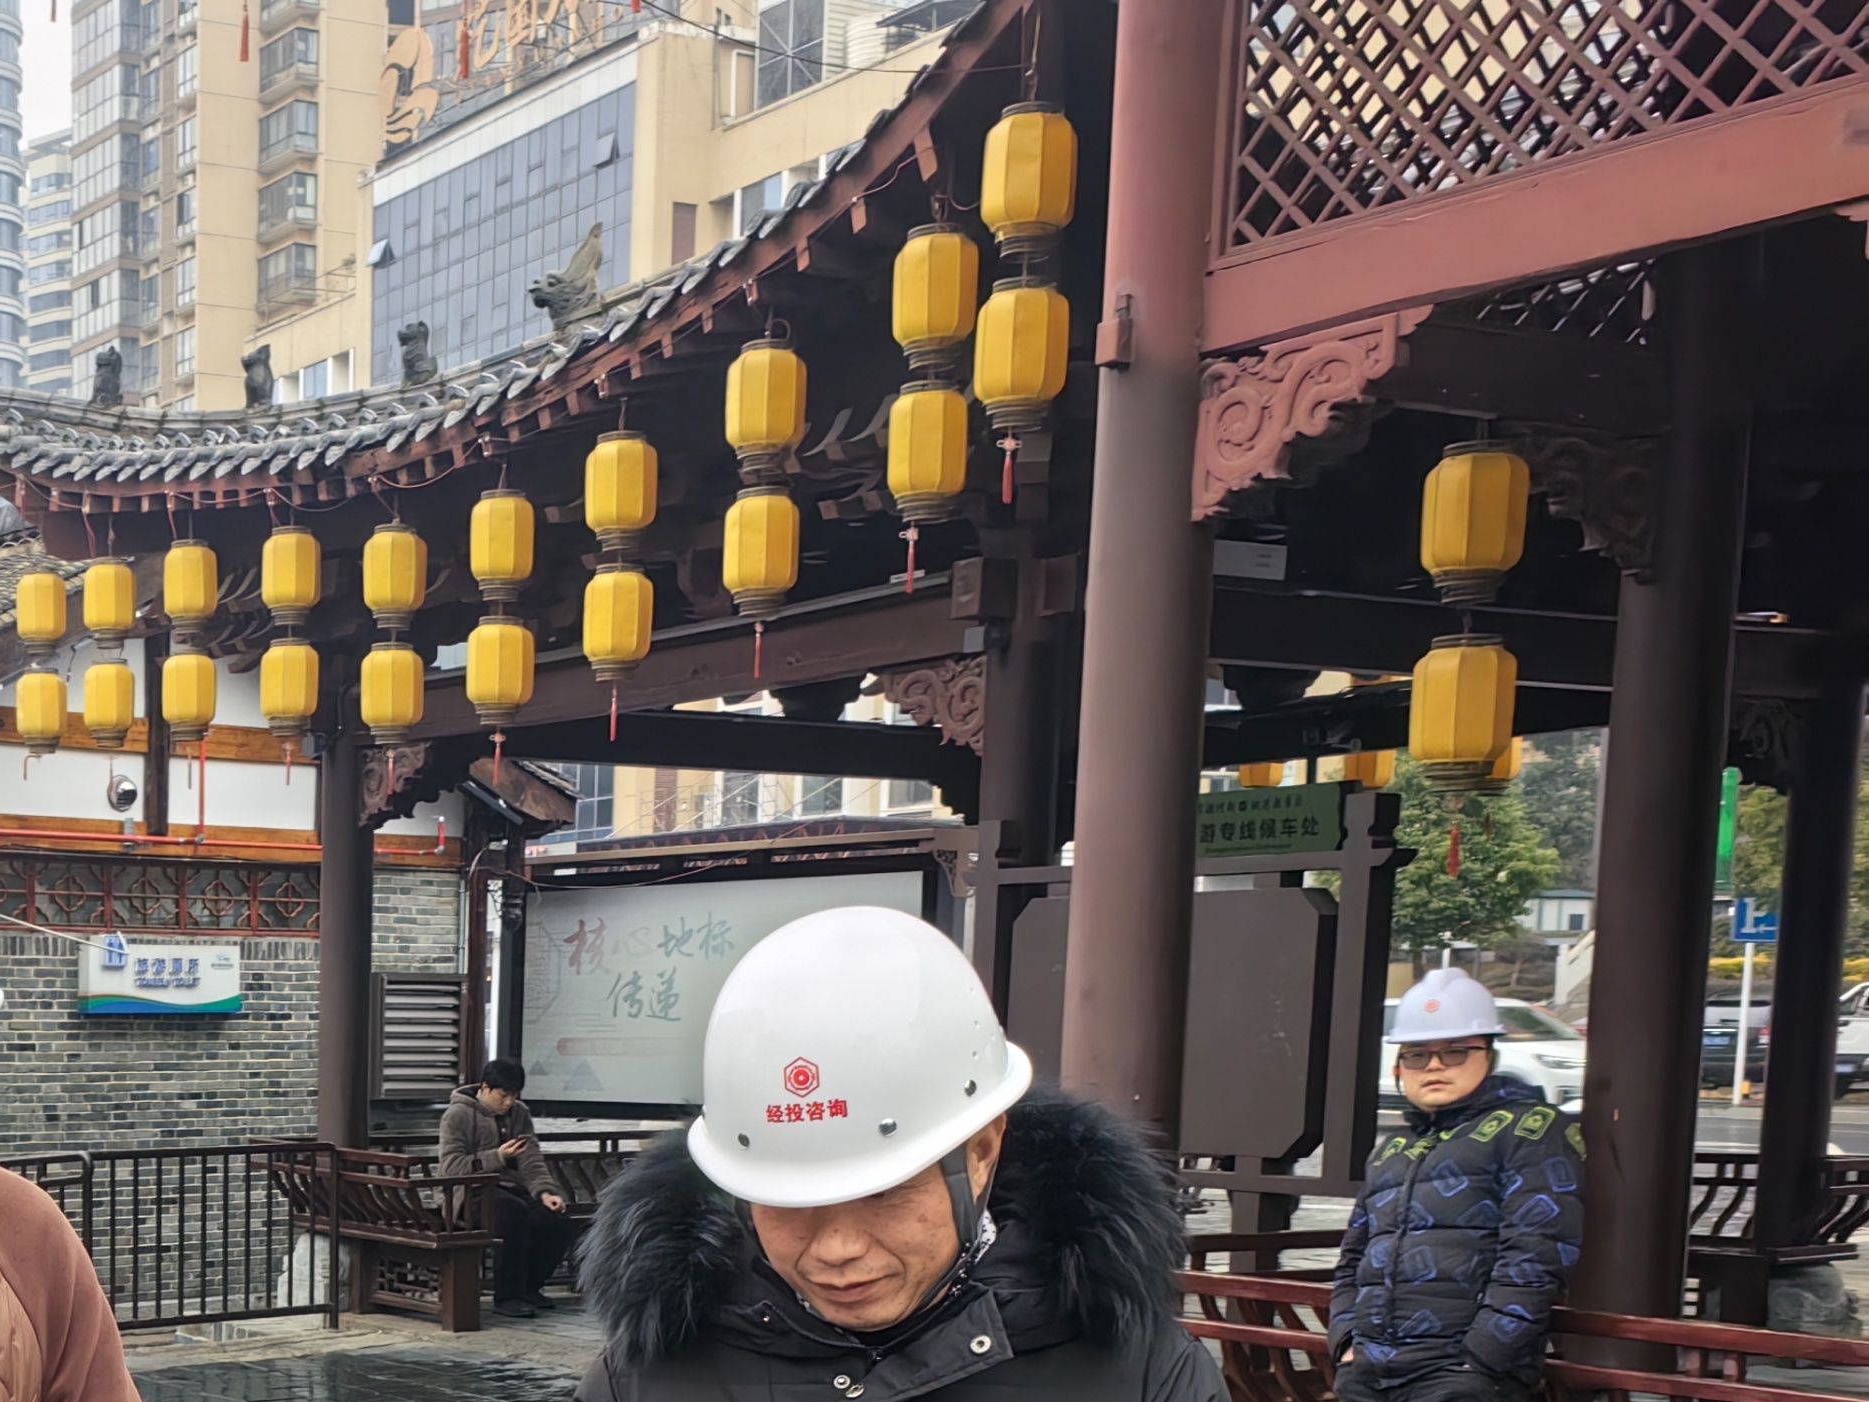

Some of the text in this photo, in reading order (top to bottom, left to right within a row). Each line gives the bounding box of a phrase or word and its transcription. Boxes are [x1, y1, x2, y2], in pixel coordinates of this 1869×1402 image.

[607, 966, 682, 1023] 传递
[765, 1098, 848, 1123] 经投咨询
